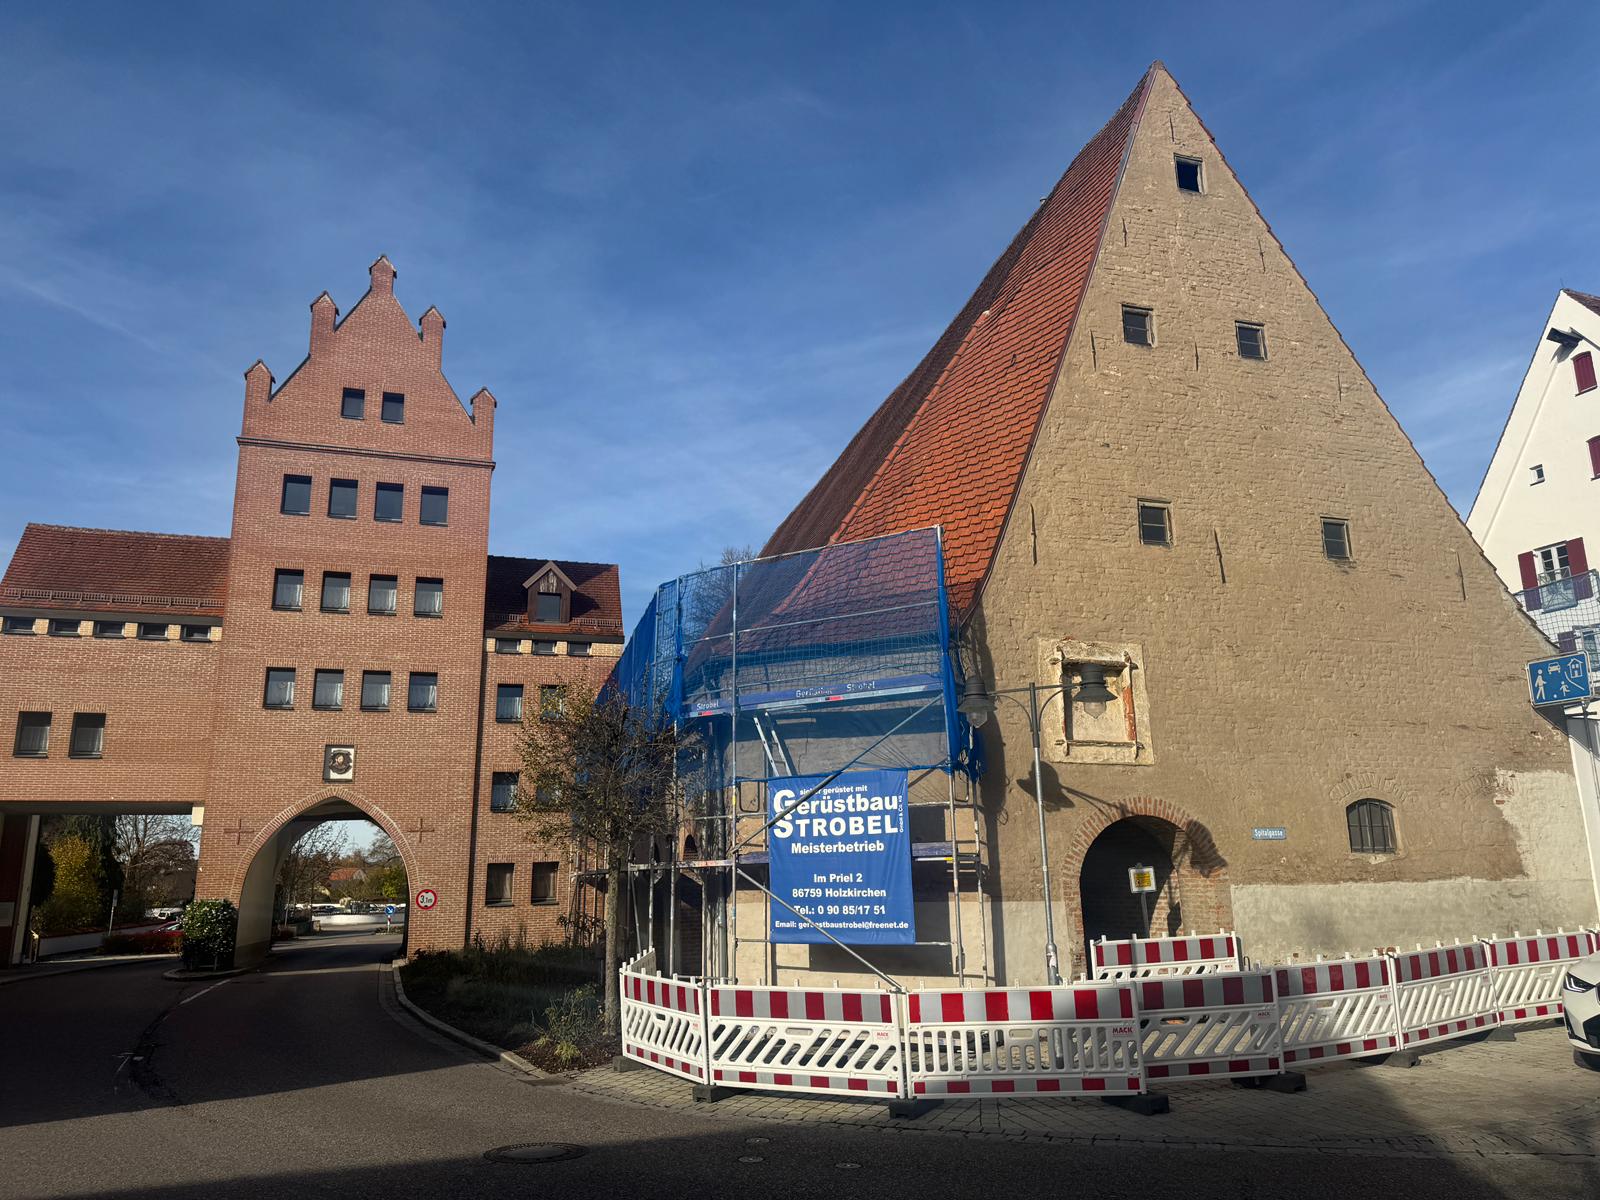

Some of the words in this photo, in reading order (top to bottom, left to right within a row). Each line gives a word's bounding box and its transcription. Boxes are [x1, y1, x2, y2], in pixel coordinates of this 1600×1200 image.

[799, 788, 822, 796] sicr
[823, 786, 854, 796] gerüstet
[855, 785, 868, 793] mit
[773, 789, 898, 815] Gerüstbau
[773, 812, 899, 838] STROBEL
[791, 841, 884, 854] Meisterbetrieb
[813, 873, 827, 883] Im
[829, 872, 854, 883] Priel
[855, 872, 864, 883] 2
[792, 888, 823, 898] 86759
[825, 887, 887, 898] Holzkirchen
[793, 905, 816, 915] Tel.:
[817, 905, 825, 915] 0
[826, 905, 840, 915] 90
[842, 904, 871, 915] 85/17
[873, 904, 886, 915] 51
[774, 920, 797, 928] Email:
